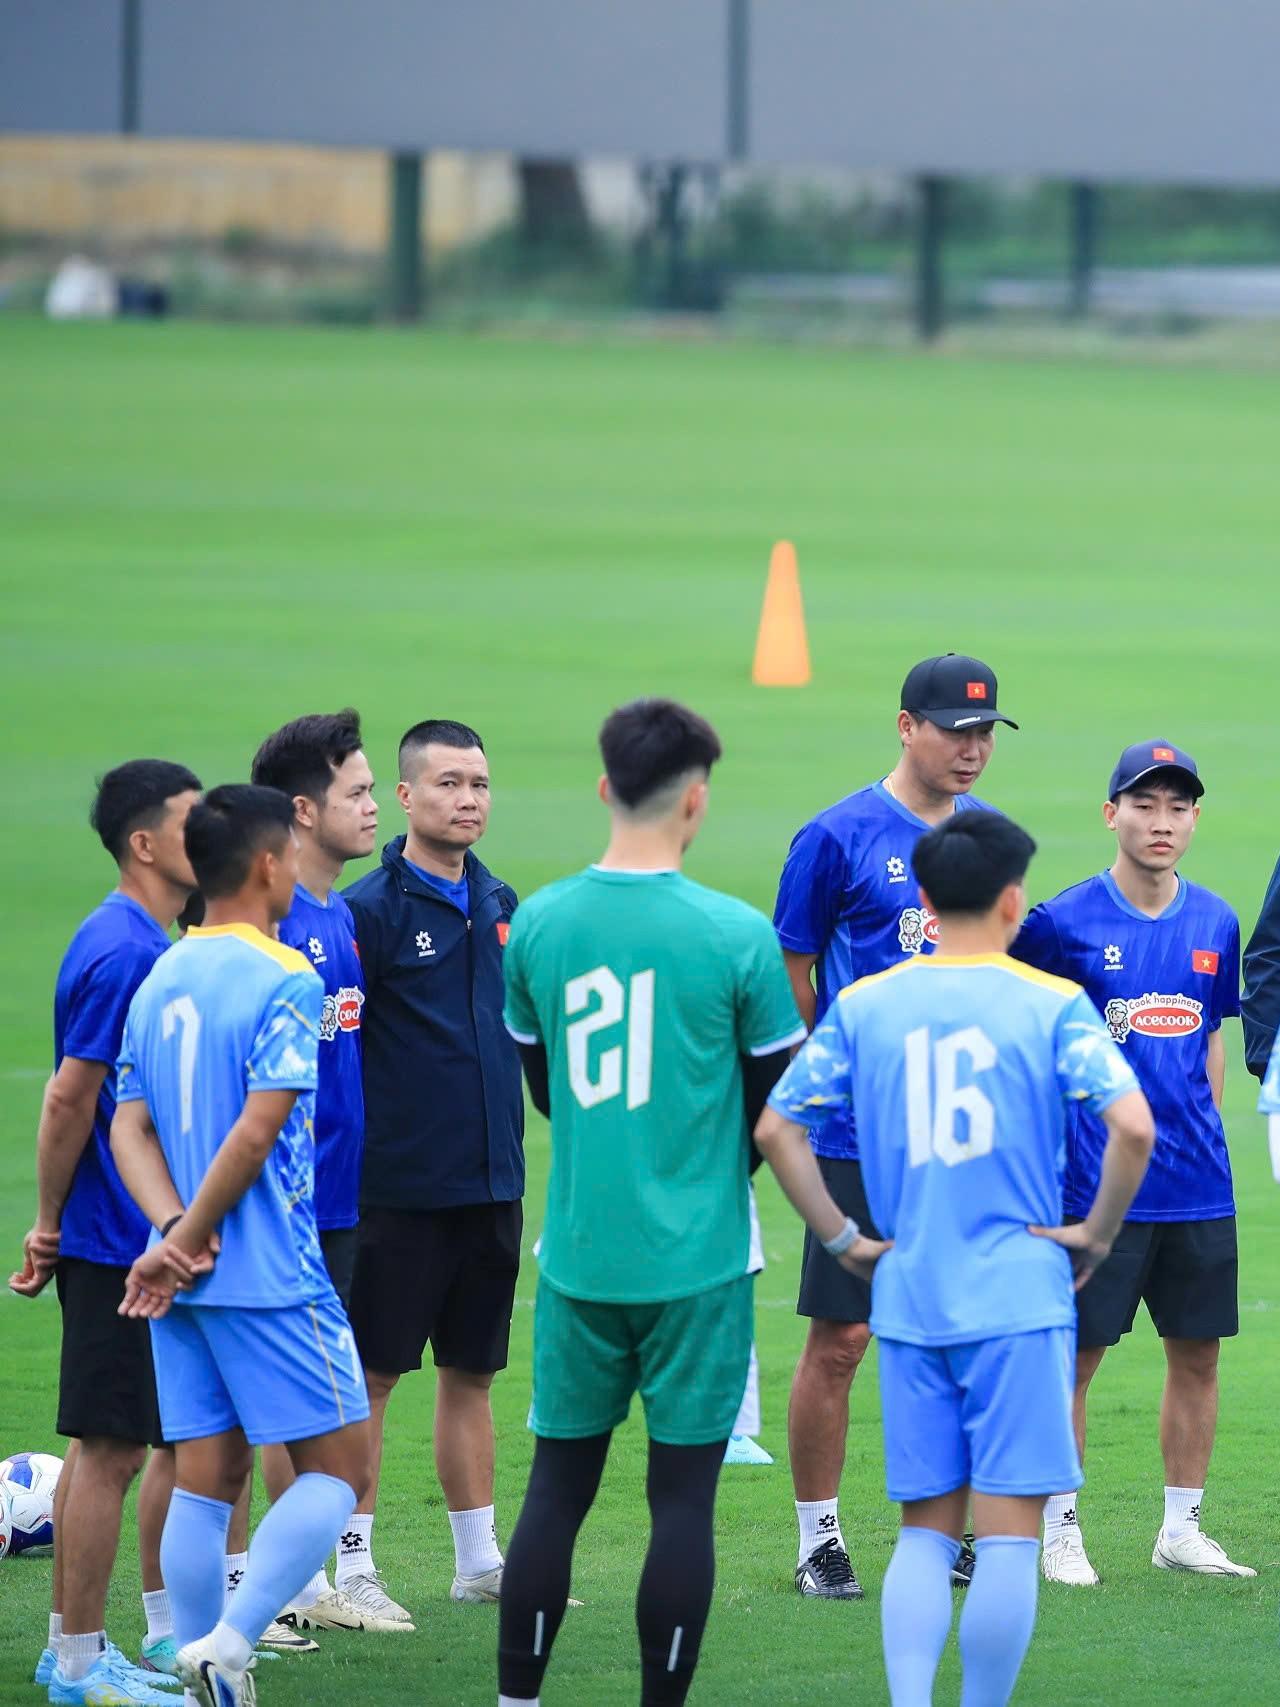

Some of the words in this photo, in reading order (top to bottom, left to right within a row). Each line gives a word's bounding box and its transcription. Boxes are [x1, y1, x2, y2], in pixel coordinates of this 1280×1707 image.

[162, 996, 200, 1133] 7
[564, 966, 655, 1110] 21
[1129, 996, 1151, 1010] Cook
[1153, 994, 1201, 1011] happiness
[904, 1025, 998, 1168] 16
